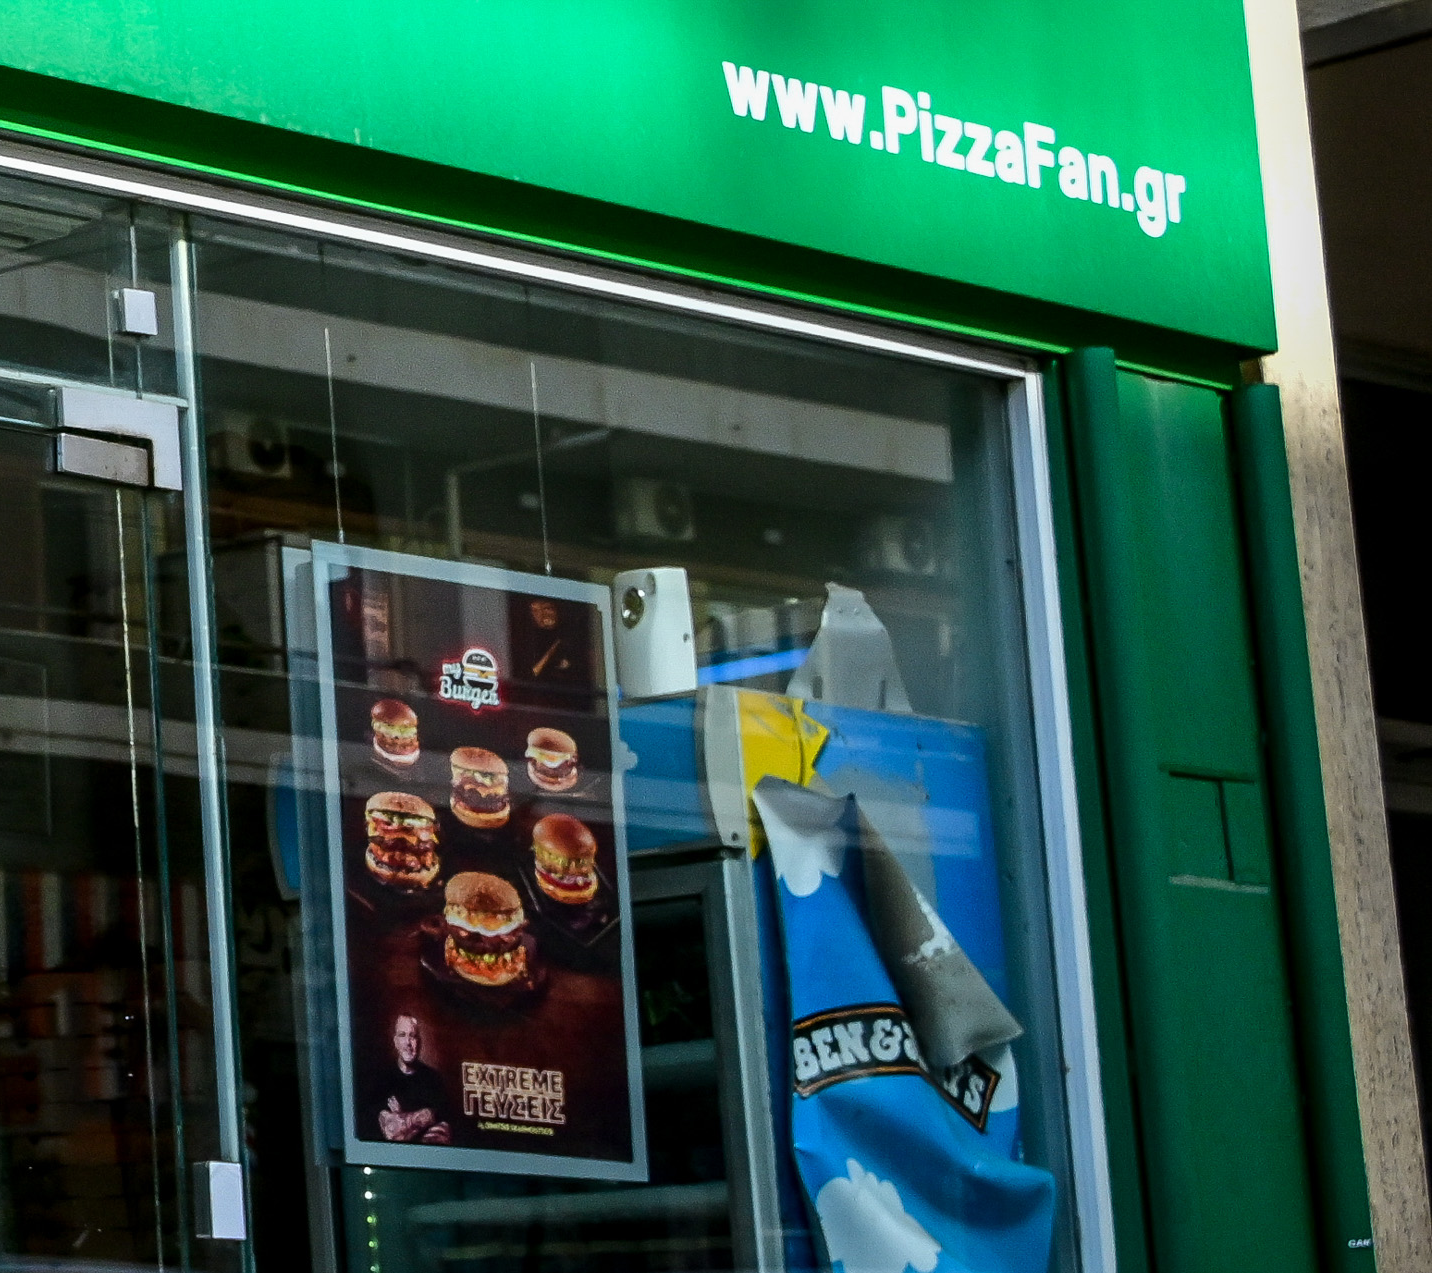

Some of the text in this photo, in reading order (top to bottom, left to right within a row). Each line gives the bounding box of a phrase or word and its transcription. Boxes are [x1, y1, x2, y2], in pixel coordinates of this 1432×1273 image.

[722, 60, 1186, 237] www.PizzaFan.gr
[462, 1061, 564, 1093] EXTREME
[463, 1088, 566, 1125] ΓΕΥΣΕΙΣ
